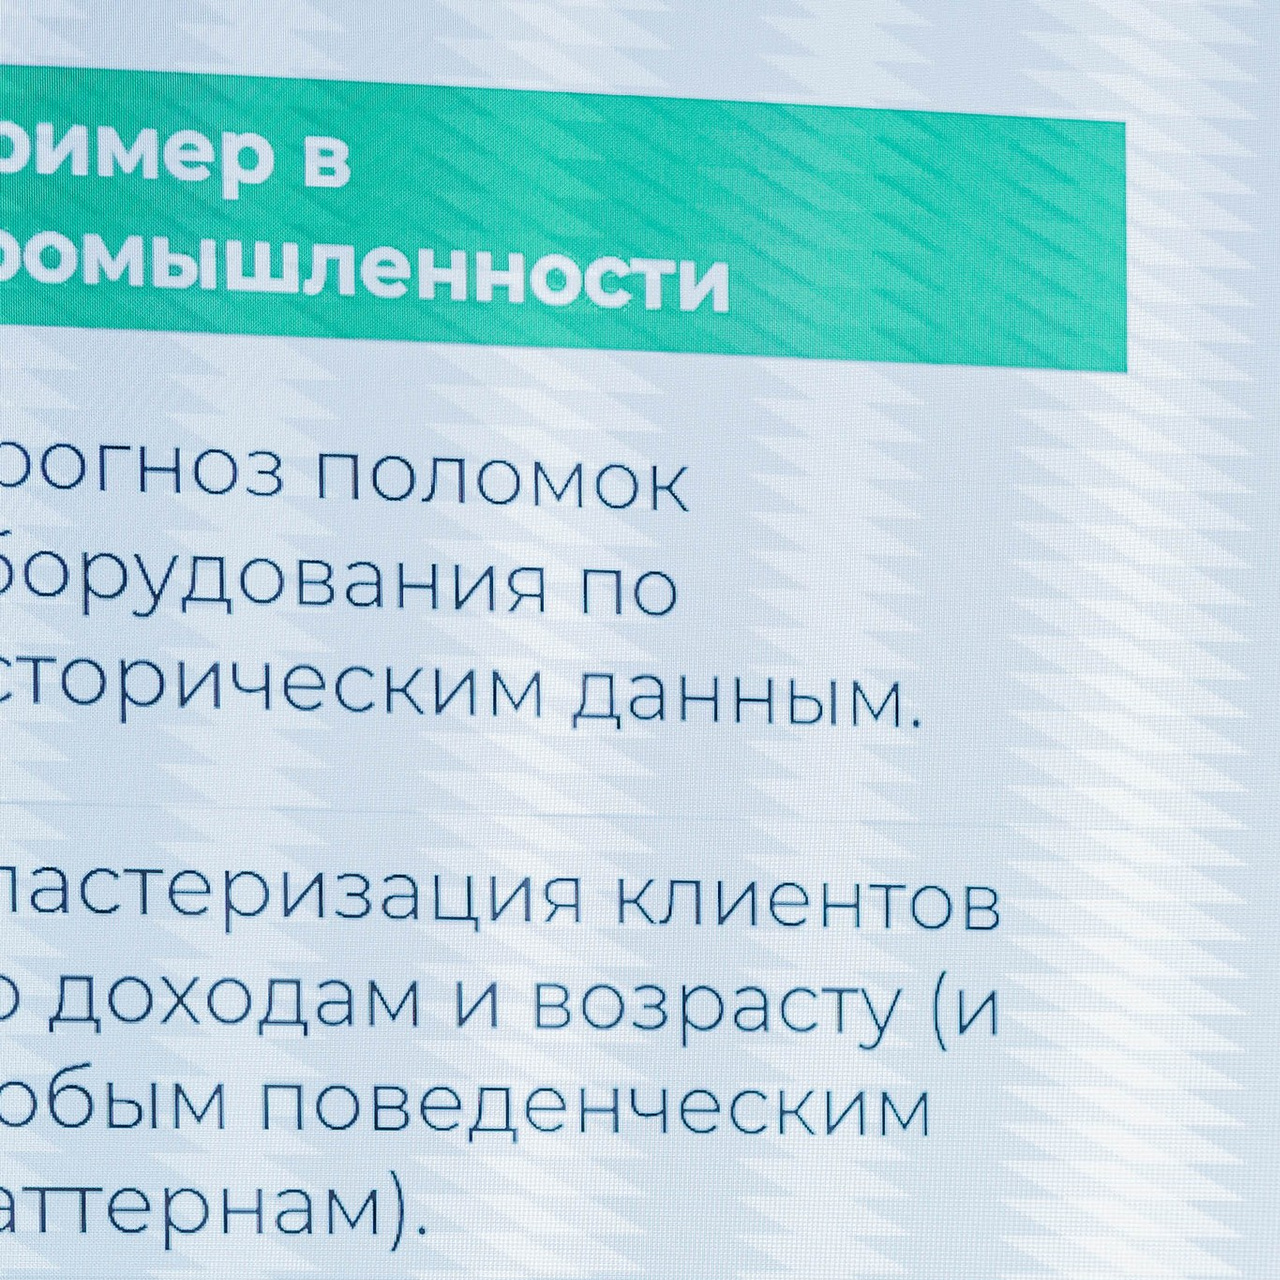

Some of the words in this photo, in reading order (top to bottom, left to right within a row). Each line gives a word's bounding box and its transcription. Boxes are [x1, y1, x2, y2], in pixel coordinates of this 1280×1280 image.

[304, 136, 351, 188] в
[317, 452, 690, 513] поломок
[0, 529, 546, 618] орудования
[581, 567, 679, 618] по
[0, 656, 542, 724] торическим
[571, 671, 922, 731] данным.
[617, 877, 1001, 932] клиентов
[48, 974, 420, 1037] доходам
[455, 980, 499, 1029] и
[534, 981, 904, 1052] возрасту
[932, 969, 999, 1053] (и
[0, 1061, 226, 1131] обым
[261, 1082, 930, 1145] поведенческим
